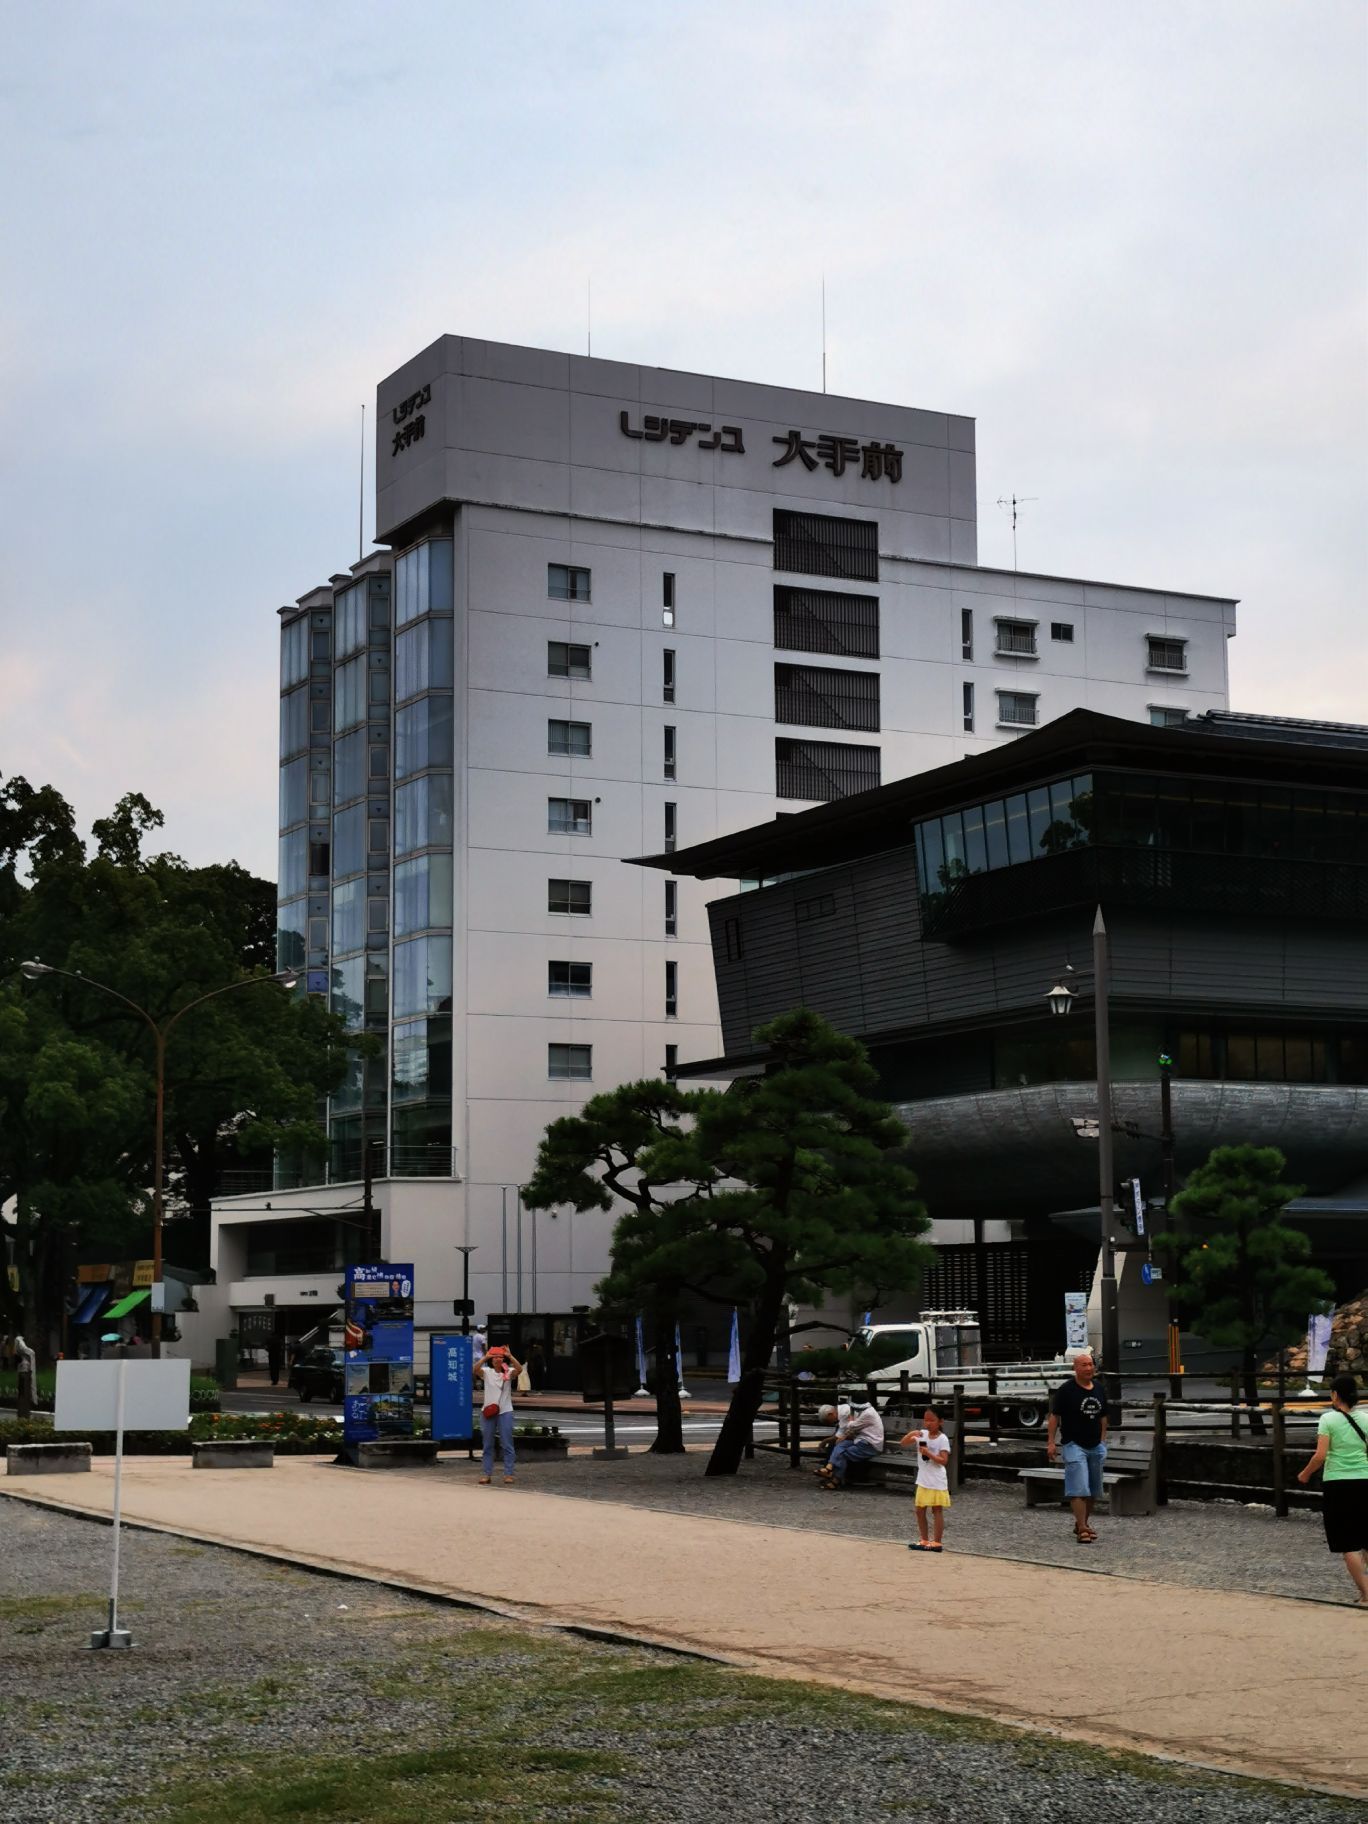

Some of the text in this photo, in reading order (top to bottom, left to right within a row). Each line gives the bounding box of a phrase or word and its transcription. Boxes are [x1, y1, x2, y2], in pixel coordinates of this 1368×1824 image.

[392, 414, 425, 457] 大手前
[620, 411, 904, 483] レジデンス 大手前
[447, 1347, 458, 1382] 高知城
